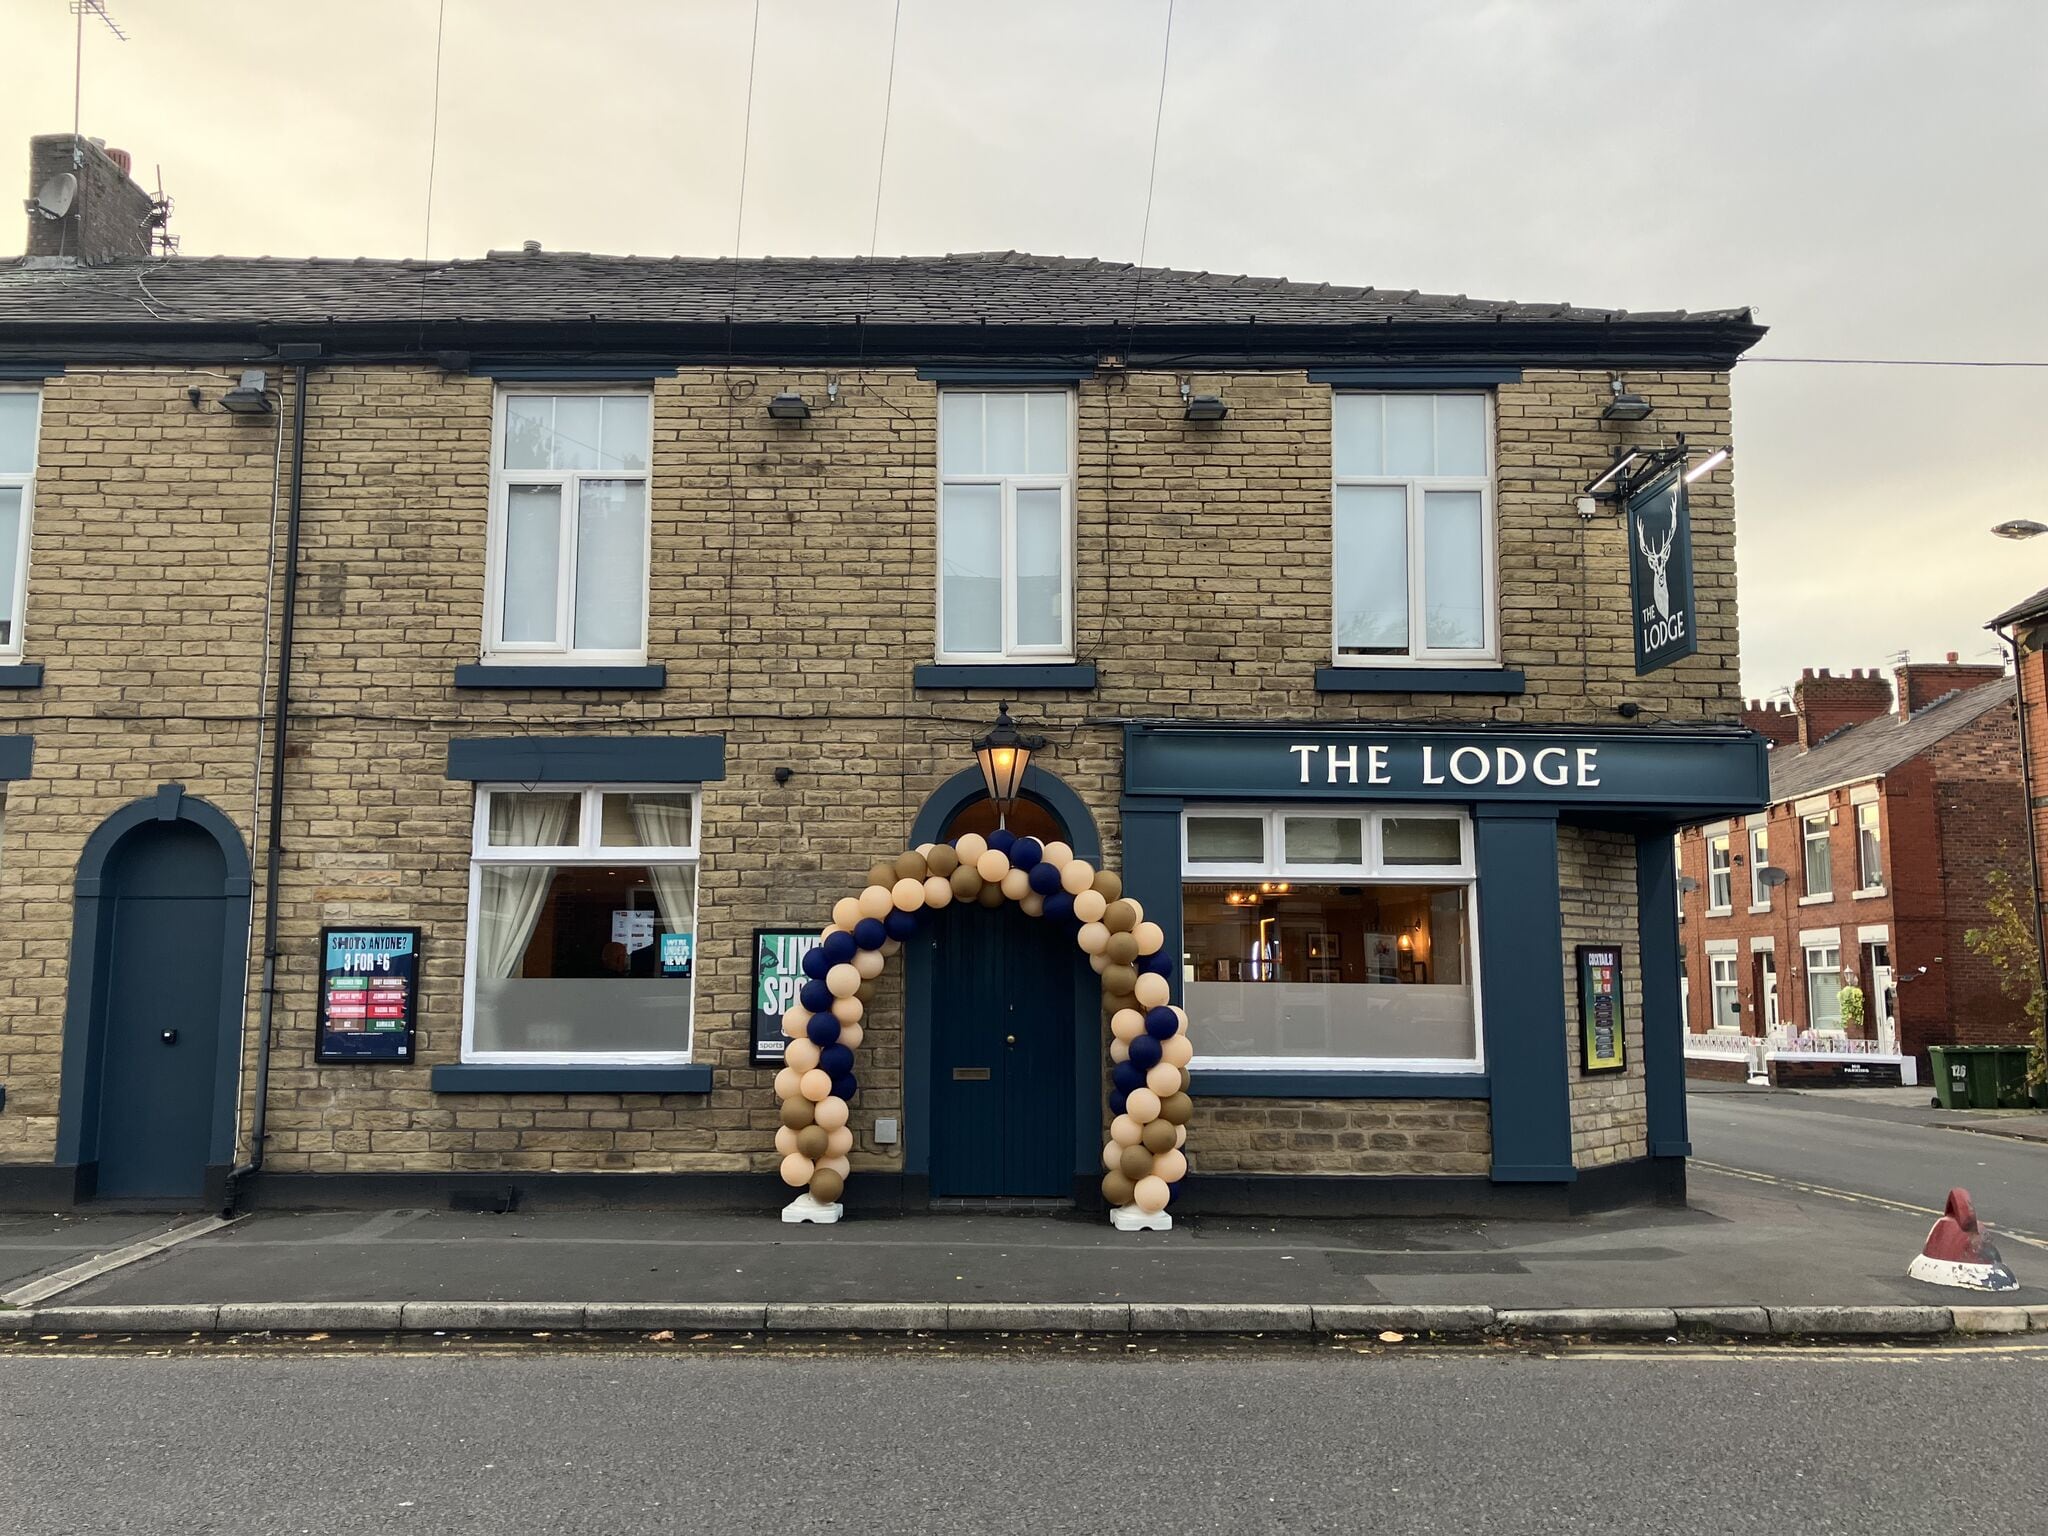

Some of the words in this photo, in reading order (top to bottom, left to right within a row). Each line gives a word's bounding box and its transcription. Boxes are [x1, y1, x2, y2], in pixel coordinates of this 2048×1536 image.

[1642, 604, 1656, 624] THE
[1643, 611, 1685, 653] LODGE
[1289, 745, 1392, 785] THE
[1421, 745, 1602, 787] LODGE
[332, 936, 366, 950] SHOTS
[369, 936, 408, 950] ANYONE?
[344, 953, 352, 971] 3
[354, 953, 374, 972] FOR
[376, 953, 391, 972] £6
[665, 955, 687, 966] NEW
[776, 936, 821, 975] LIV
[1951, 1064, 1966, 1078] 126
